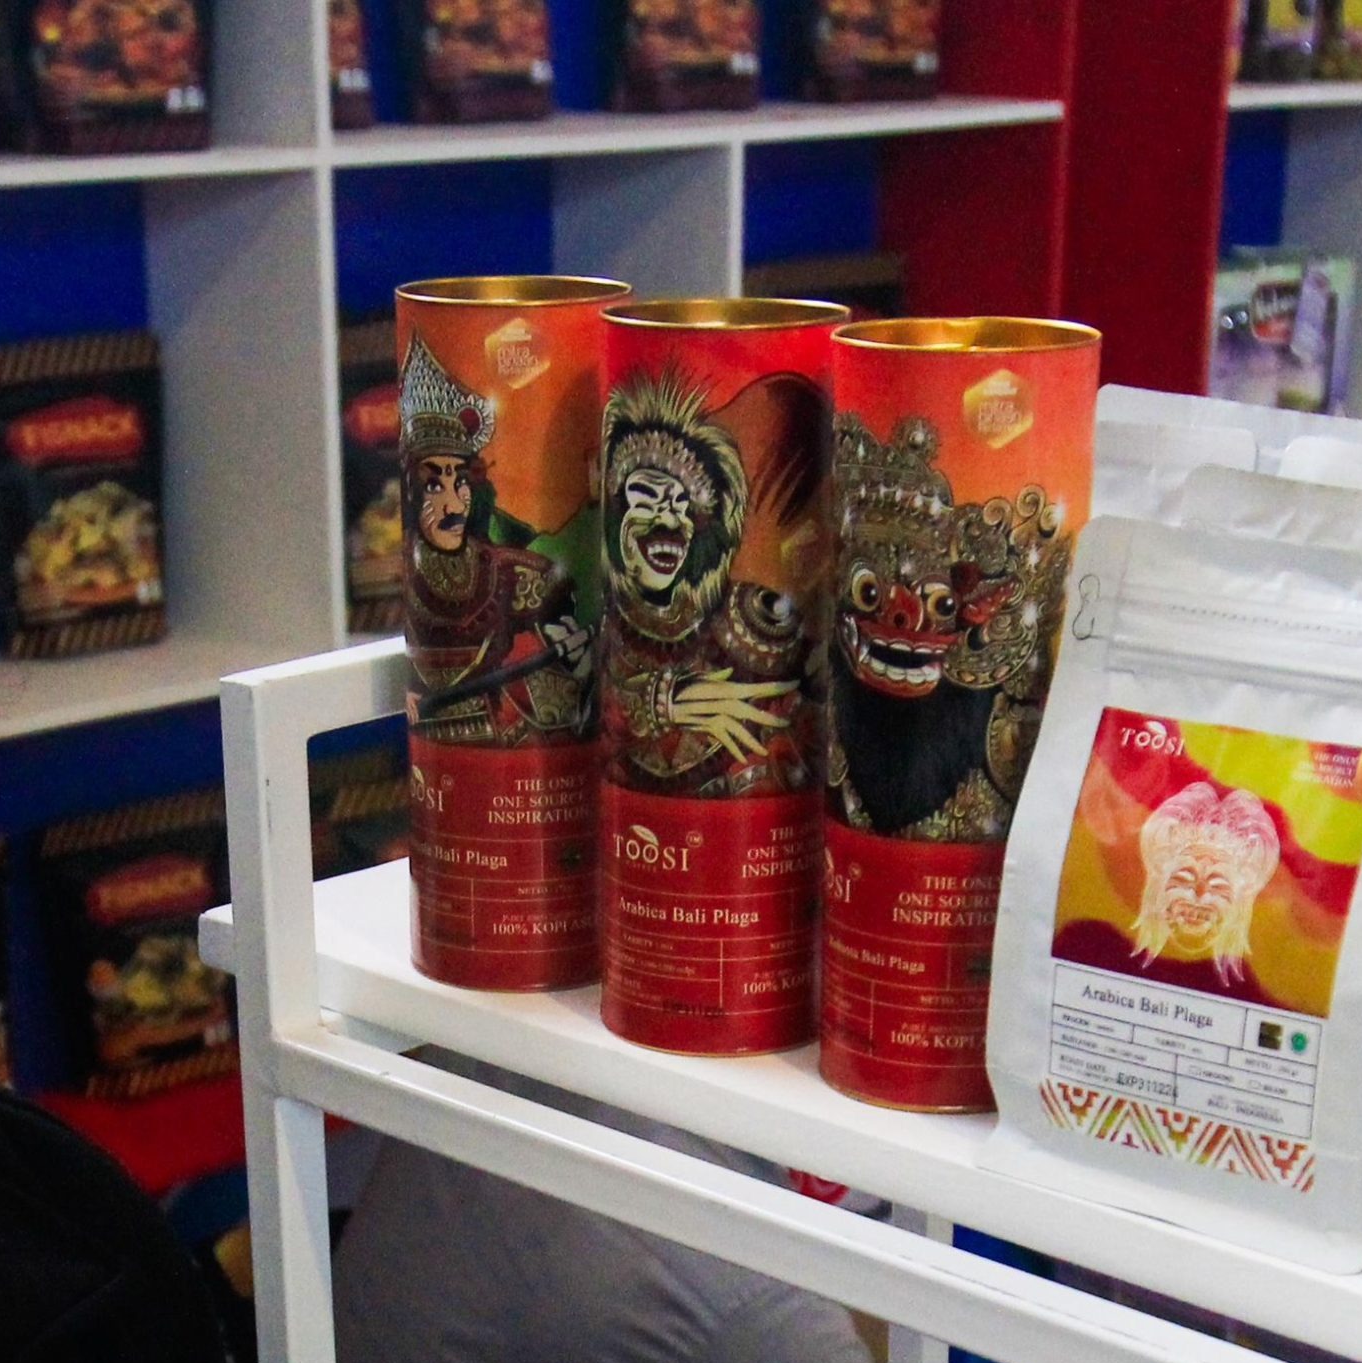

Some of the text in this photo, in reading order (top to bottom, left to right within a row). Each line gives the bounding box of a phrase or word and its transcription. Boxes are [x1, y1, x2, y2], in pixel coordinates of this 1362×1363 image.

[1121, 724, 1185, 756] TOOSI
[515, 779, 545, 791] THE
[493, 796, 524, 808] ONE
[435, 845, 508, 870] Bali Plaga
[613, 828, 690, 872] TOOSI
[747, 846, 781, 861] ONE
[924, 876, 957, 890] THE
[899, 891, 998, 909] ONE SOURC
[620, 897, 759, 928] Arabica Bali Plaga
[893, 907, 995, 926] INSPIRATIO
[493, 922, 528, 935] 100%
[862, 949, 885, 966] Bali
[890, 956, 926, 975] Plaga
[742, 982, 778, 996] 100%
[1082, 986, 1213, 1027] Arabica Bali Plaga
[891, 1030, 929, 1048] 100%
